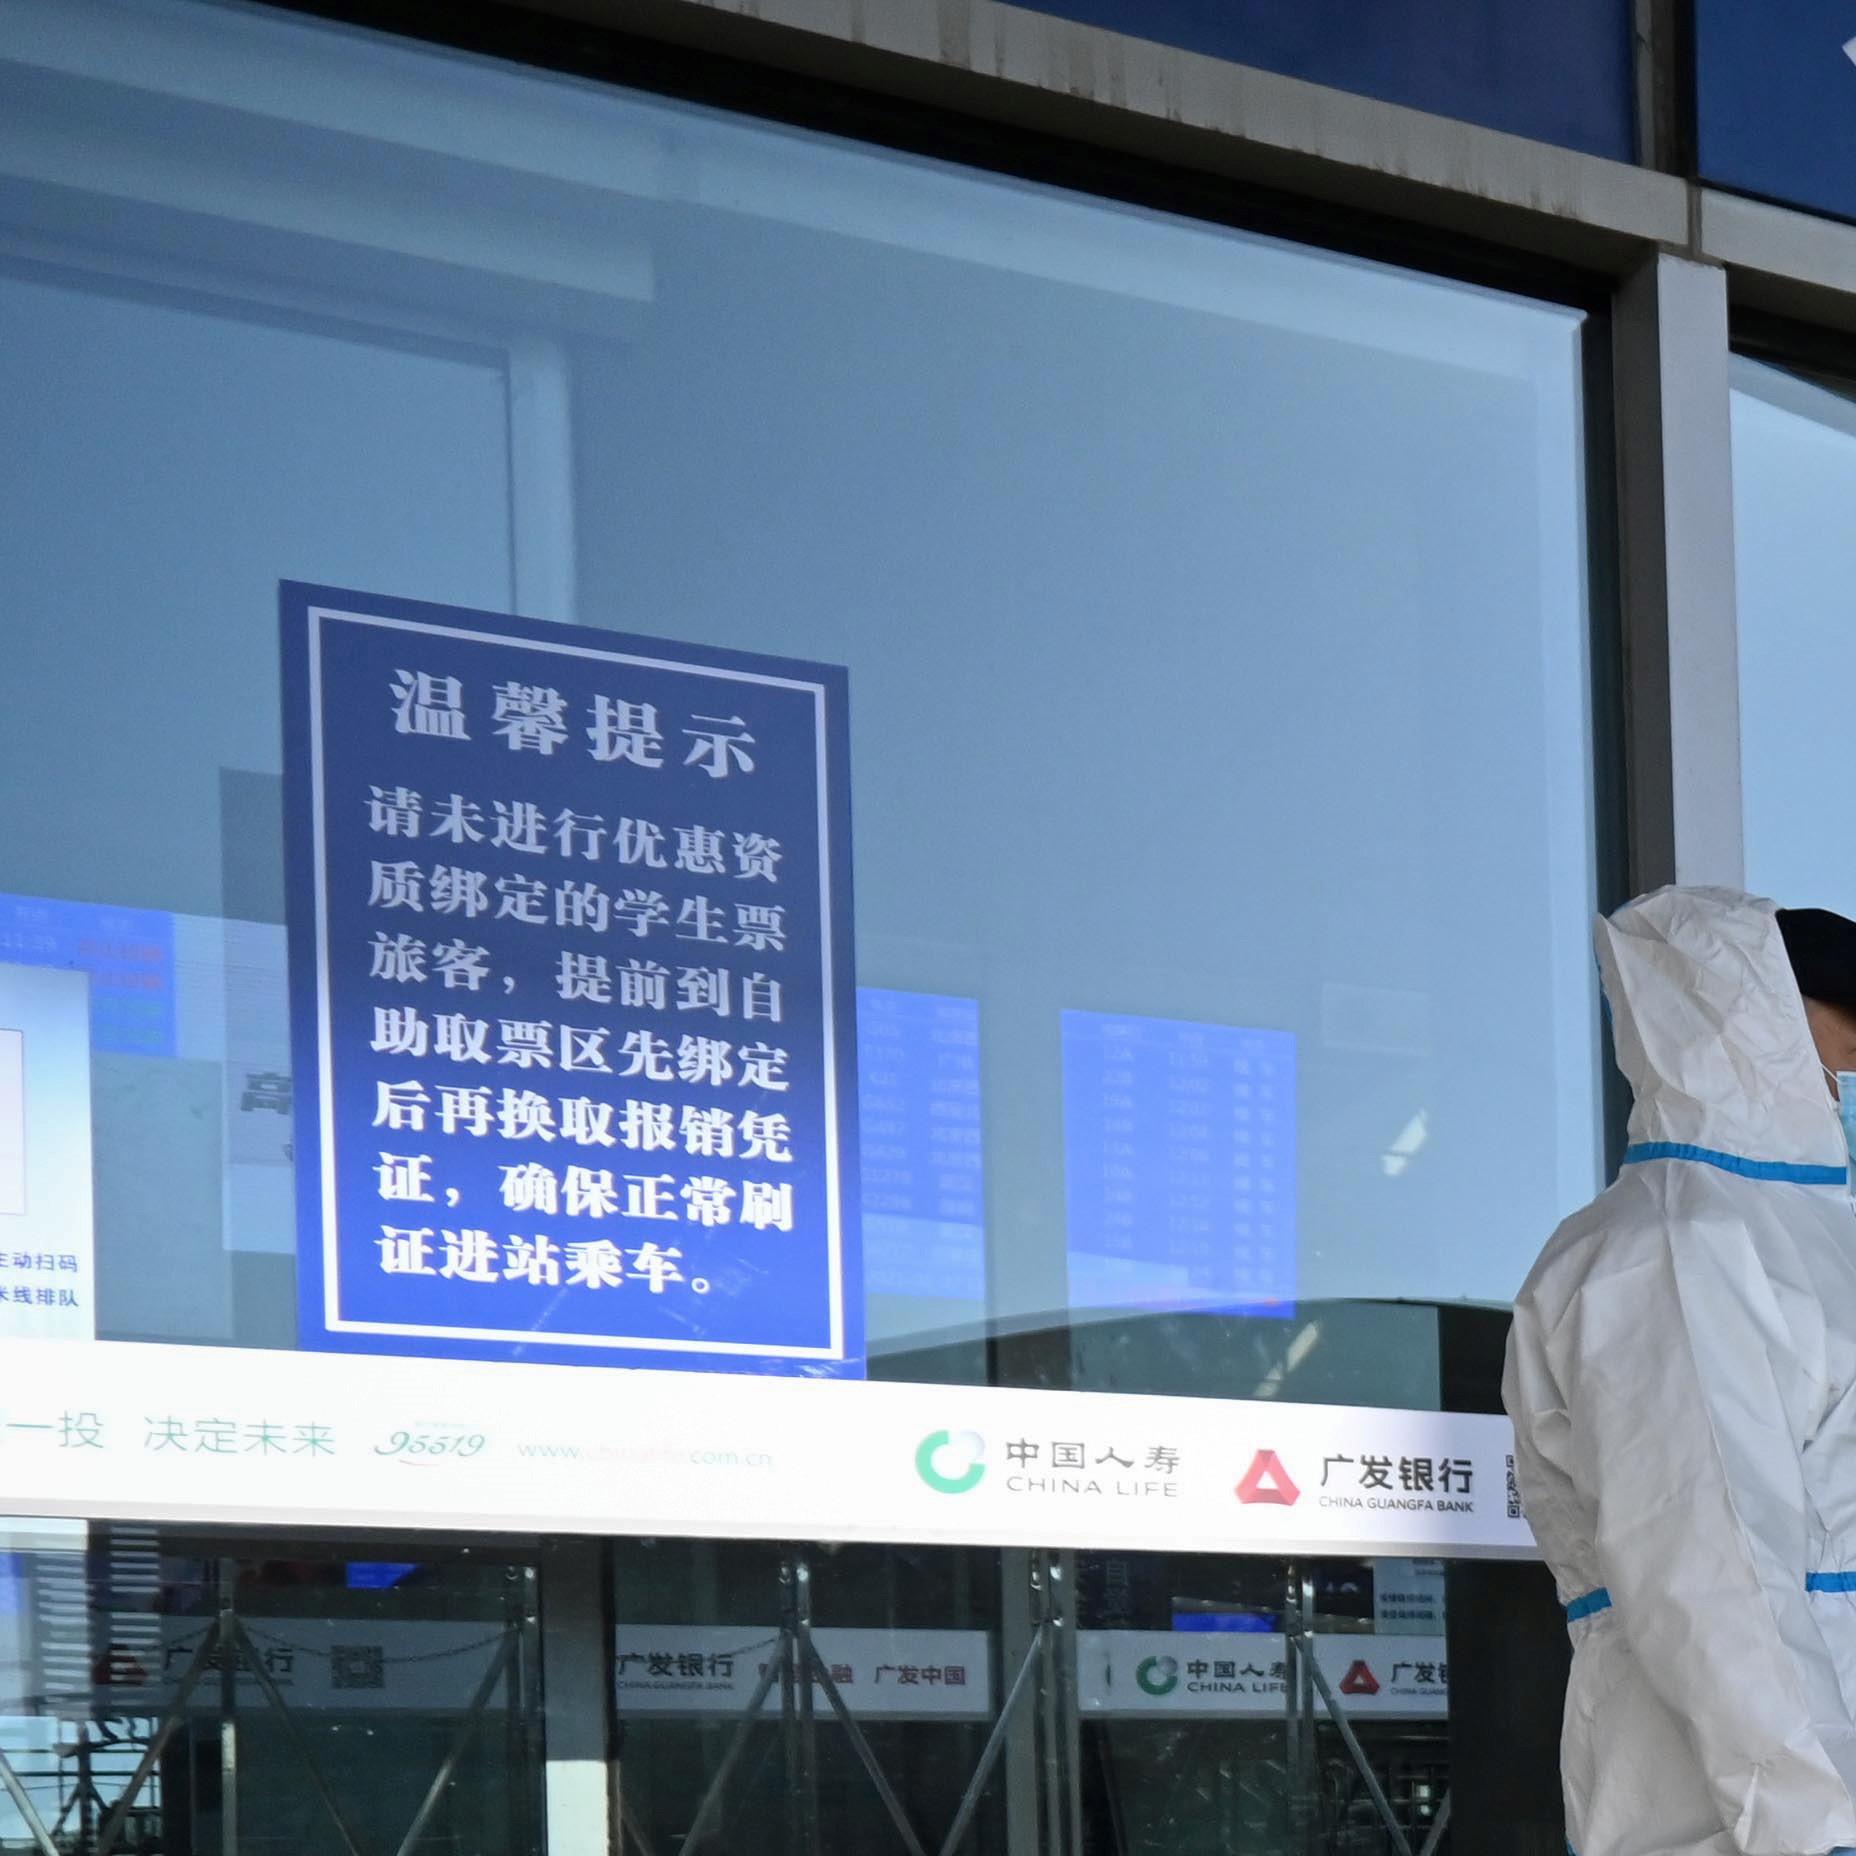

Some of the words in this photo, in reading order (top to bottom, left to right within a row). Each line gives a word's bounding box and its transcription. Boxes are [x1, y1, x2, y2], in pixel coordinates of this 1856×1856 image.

[389, 668, 757, 779] 温馨提示
[364, 785, 783, 884] 请未进行优惠资
[367, 862, 787, 953] 质绑定的学生票
[368, 932, 783, 1022] 旅客，提前到自
[370, 1007, 790, 1092] 助取票区先绑定
[372, 1081, 793, 1163] 后再换取报销凭
[374, 1152, 793, 1232] 证，确保正常刷
[376, 1226, 712, 1294] 证进站乘车。
[144, 1415, 334, 1457] 决定未来
[374, 1431, 486, 1457] 95519
[1006, 1437, 1181, 1475] 中国人寿
[1007, 1476, 1102, 1496] CHINA
[1116, 1479, 1178, 1498] LIFE
[1320, 1453, 1473, 1494] 广发银行
[1319, 1496, 1363, 1508] CHINA
[1366, 1498, 1433, 1512] GUANGFA
[1436, 1500, 1474, 1514] BANK
[618, 1652, 734, 1678] 广发银行
[874, 1664, 966, 1685] 广发中国
[1187, 1658, 1287, 1681] 中国人寿
[1187, 1681, 1243, 1693] CHINA
